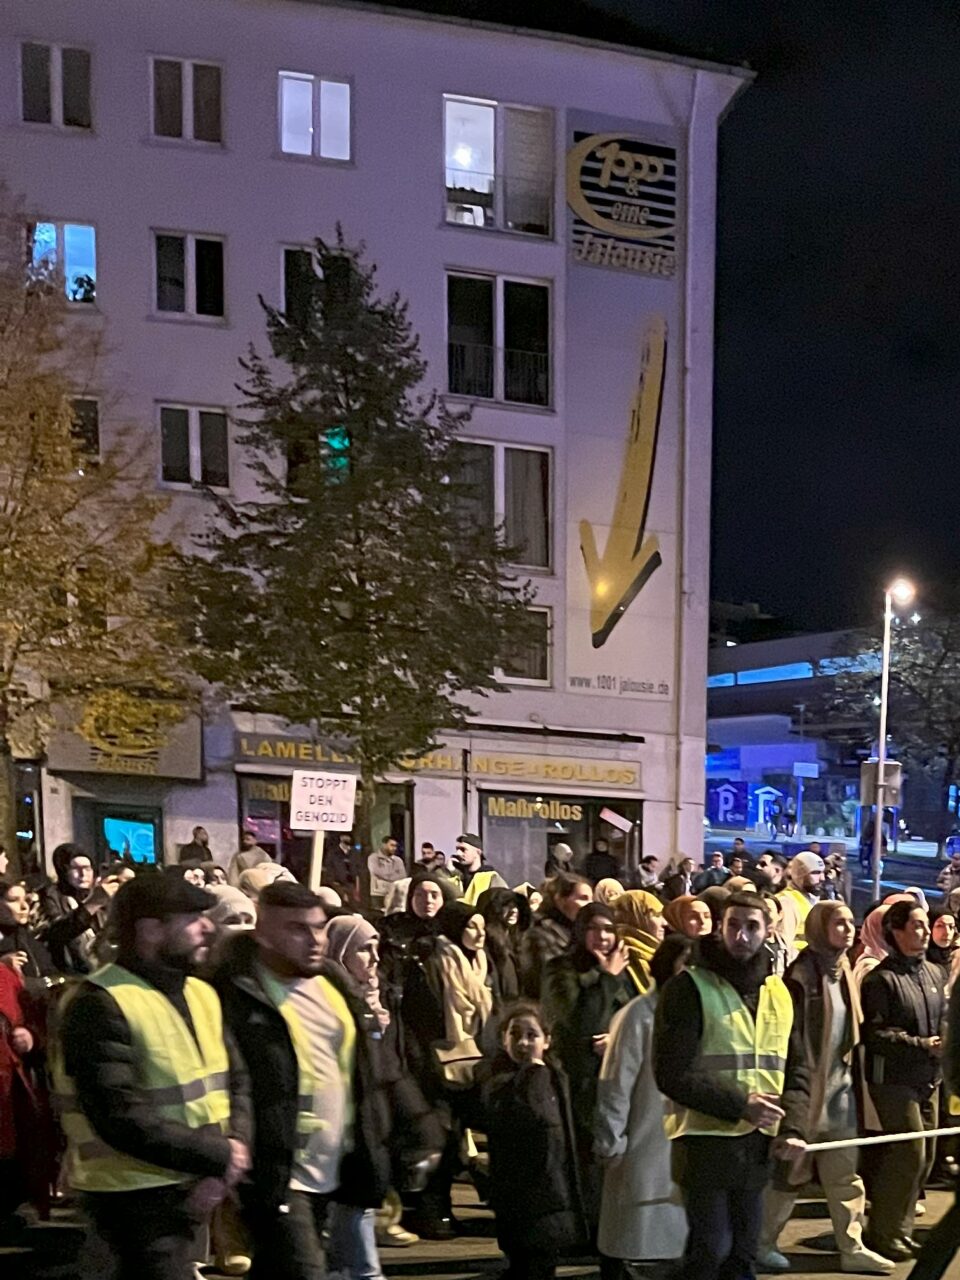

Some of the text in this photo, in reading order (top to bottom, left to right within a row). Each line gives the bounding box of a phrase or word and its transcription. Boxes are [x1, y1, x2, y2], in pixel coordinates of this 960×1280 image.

[575, 233, 677, 275] Jalousie
[240, 738, 363, 764] LAMELL
[301, 776, 347, 790] STOPPT
[309, 795, 333, 805] DEN
[488, 796, 582, 821] Maßrollos
[296, 811, 348, 823] GENOZID
